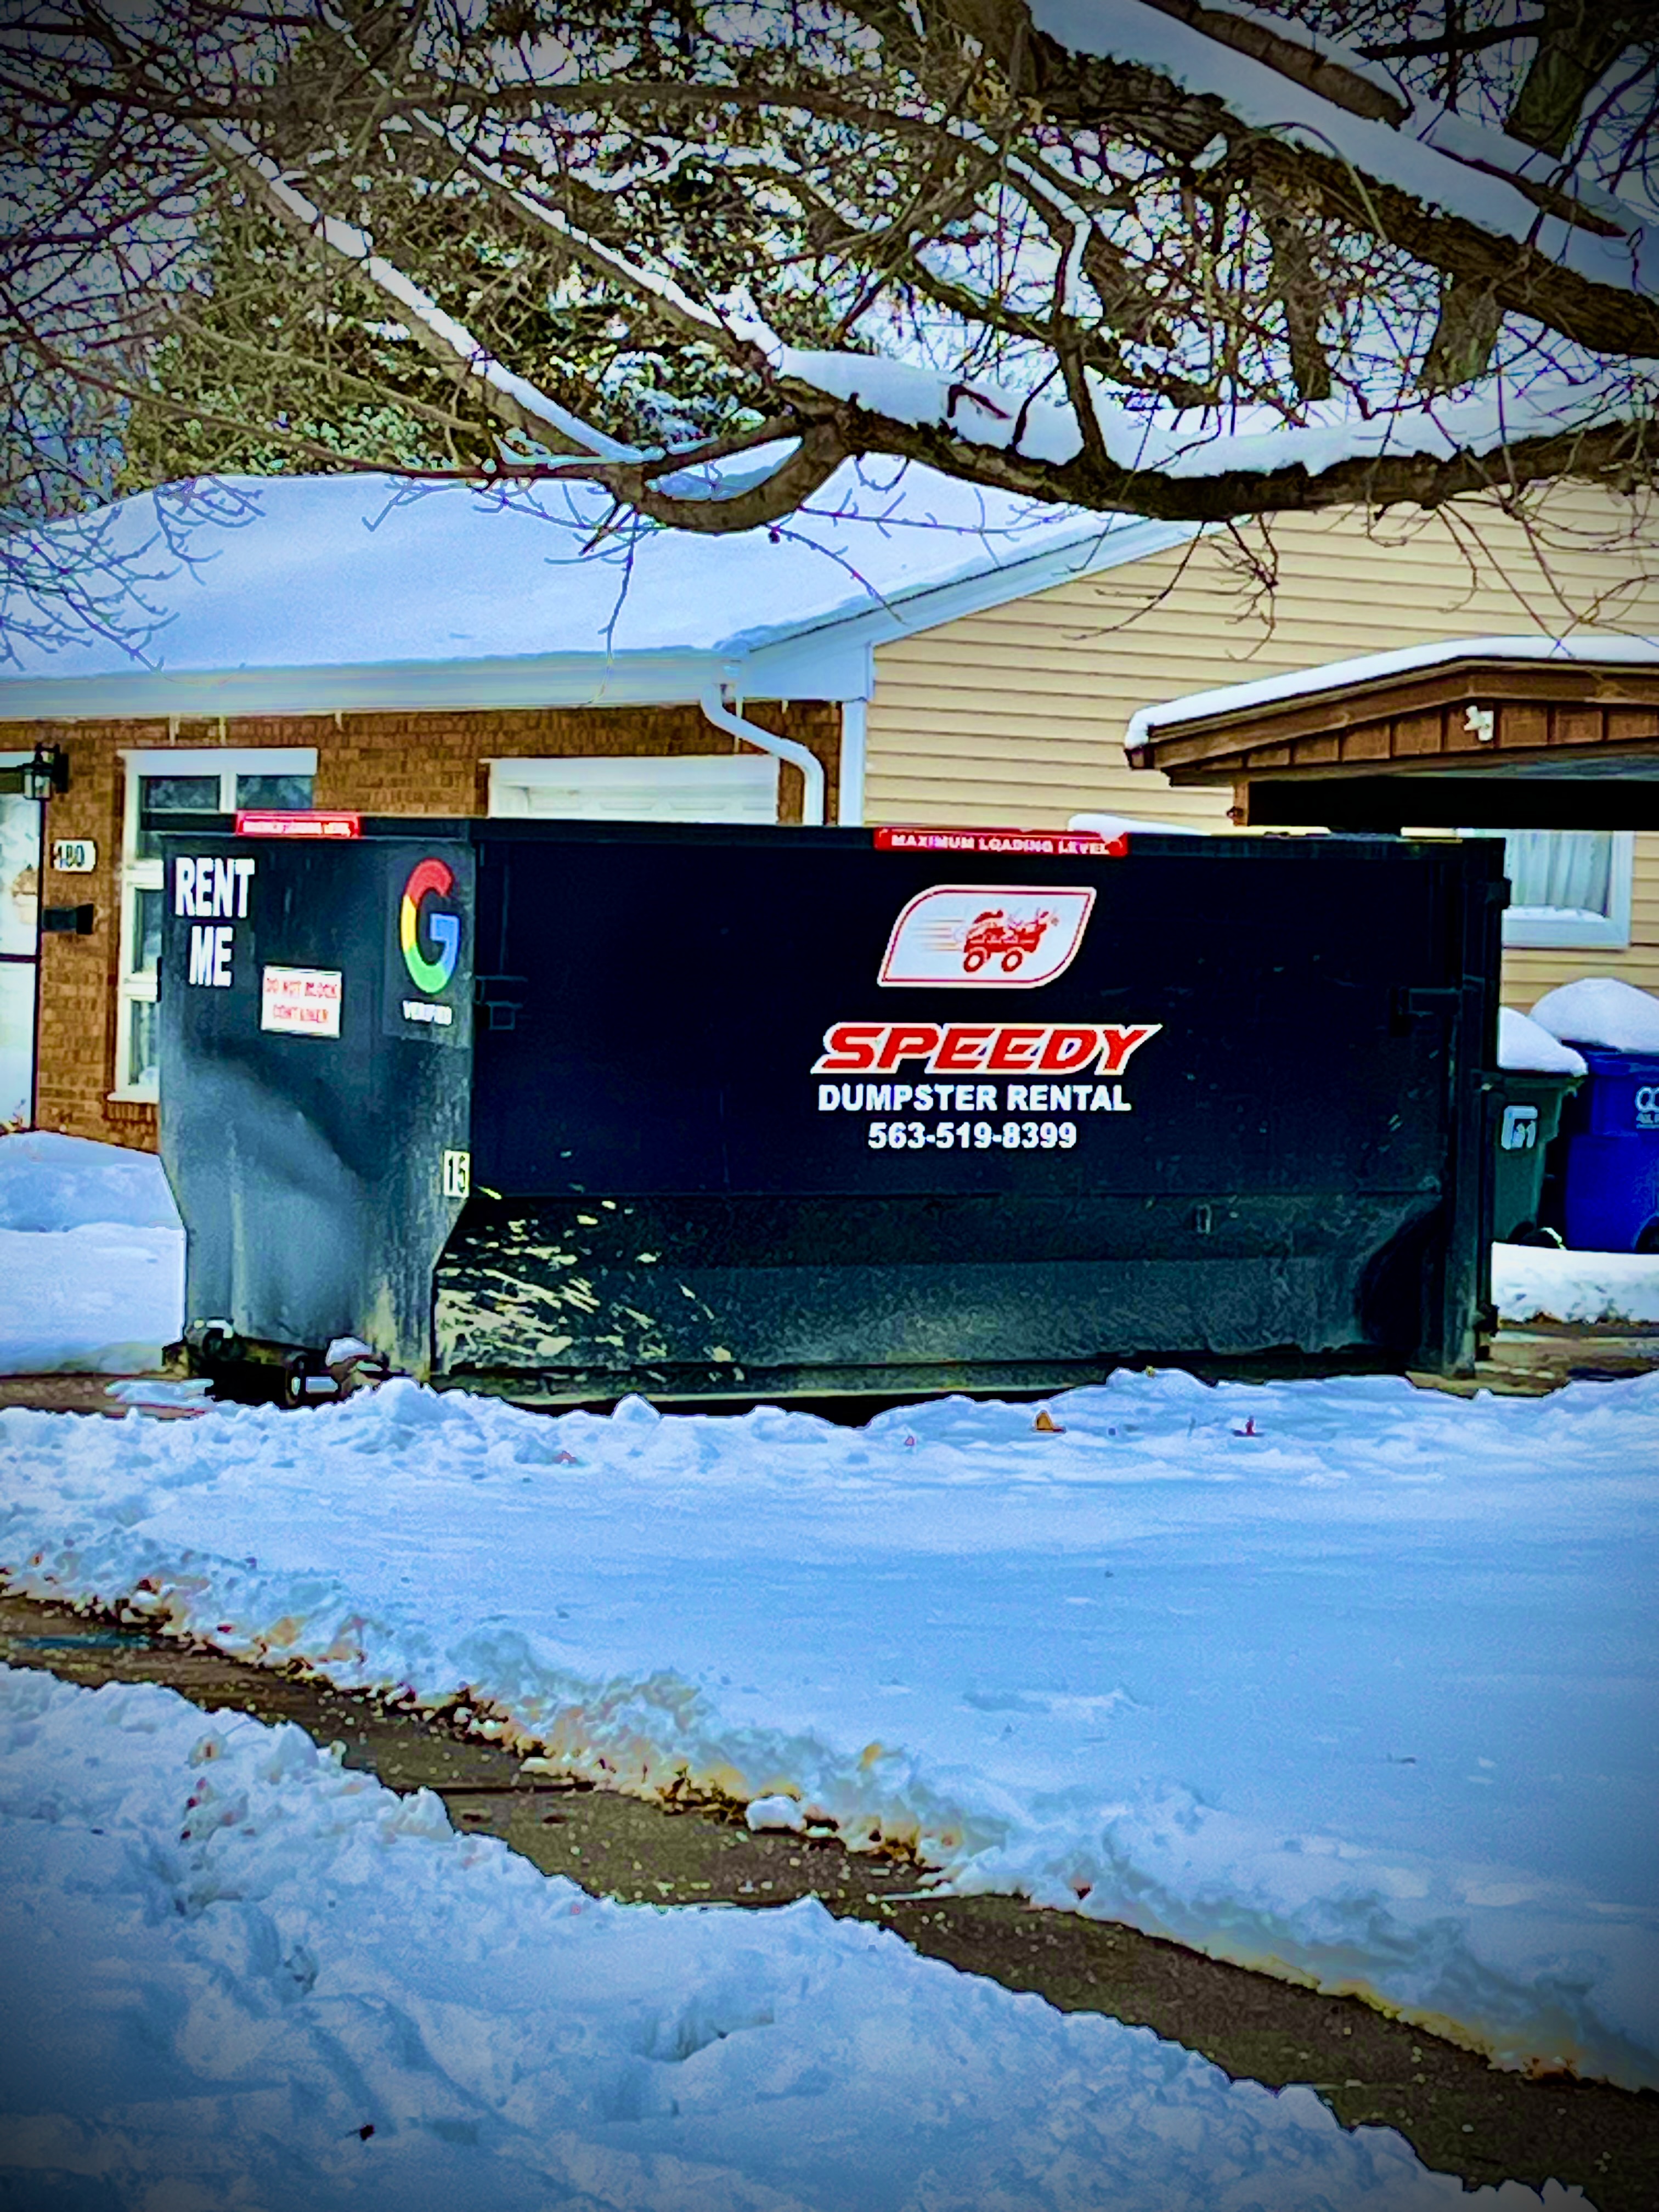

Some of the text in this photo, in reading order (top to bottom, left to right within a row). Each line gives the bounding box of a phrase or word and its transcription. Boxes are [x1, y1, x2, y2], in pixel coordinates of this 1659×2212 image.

[891, 834, 1109, 855] MAXIMUM LOADING LEVEL
[175, 857, 255, 918] RENT
[189, 926, 233, 987] ME
[811, 1022, 1163, 1075] SPEEDY
[818, 1084, 1132, 1111] DUMPSTER RENTAL
[867, 1122, 1077, 1148] 563-519-8399
[448, 1155, 466, 1194] 15
